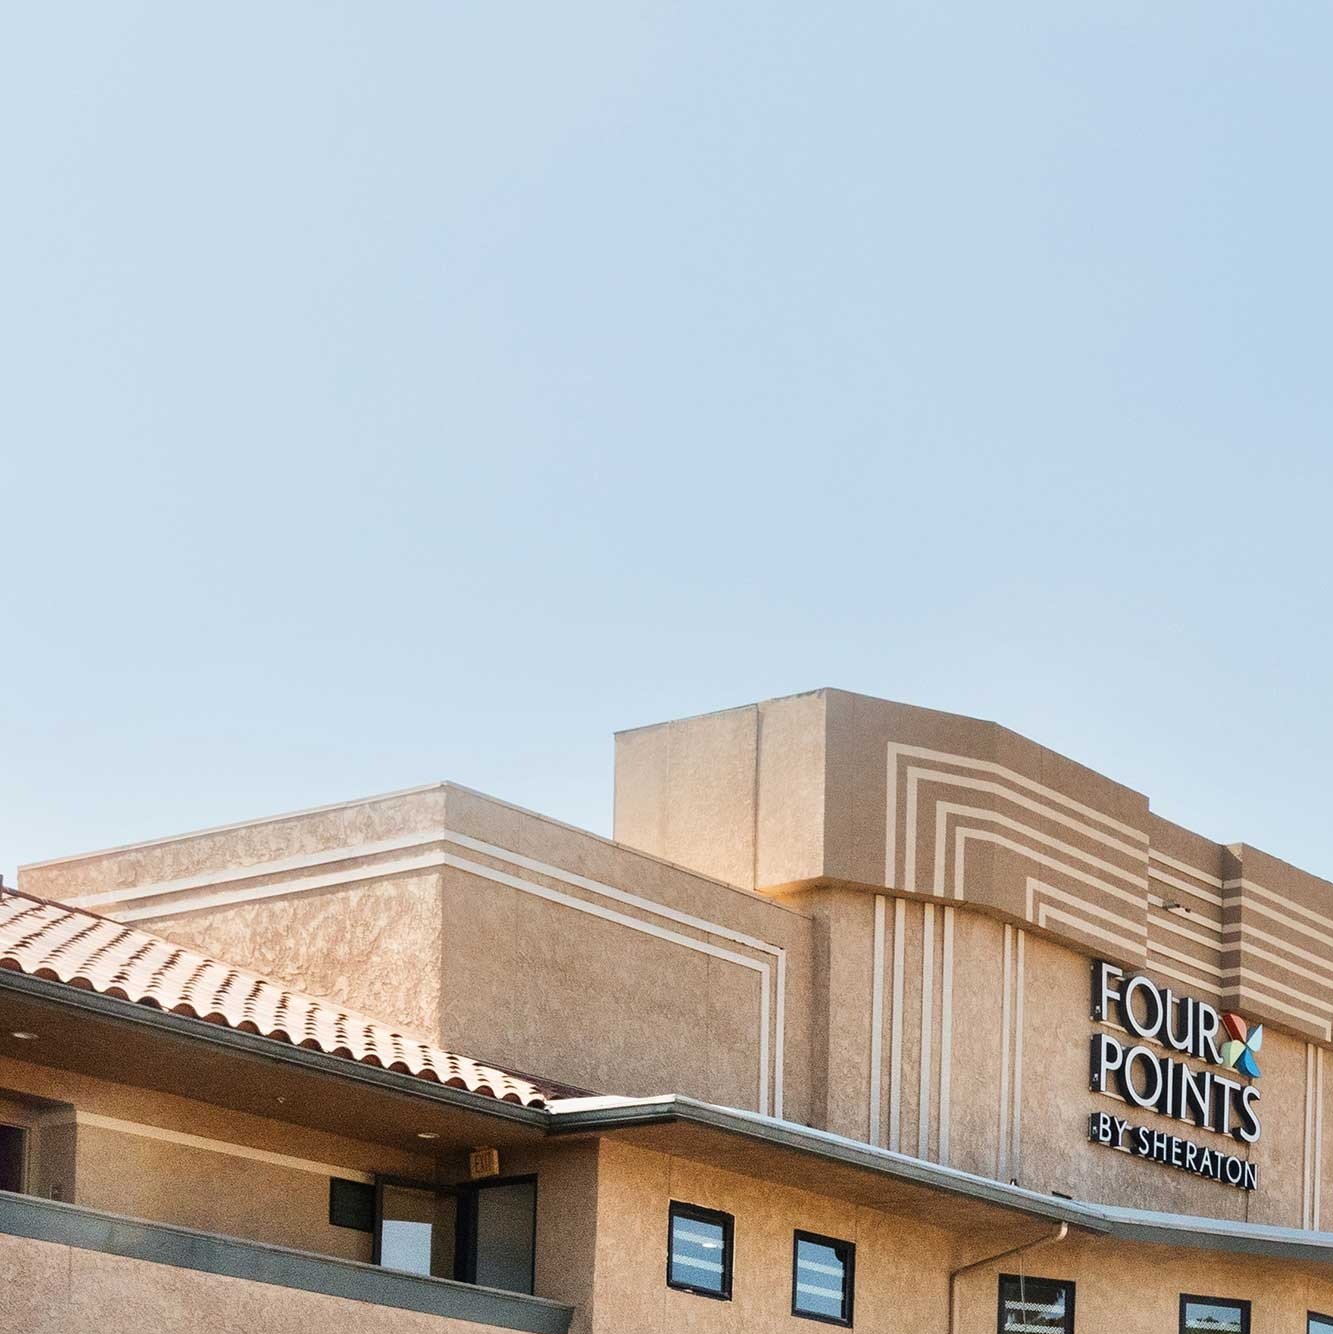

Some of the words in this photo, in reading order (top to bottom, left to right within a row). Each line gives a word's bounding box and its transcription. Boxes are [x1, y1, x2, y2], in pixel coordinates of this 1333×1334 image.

[1101, 961, 1224, 1065] FOUR
[1099, 1034, 1262, 1143] POINTS
[1098, 1112, 1128, 1146] BY
[1138, 1125, 1258, 1190] SHERATON
